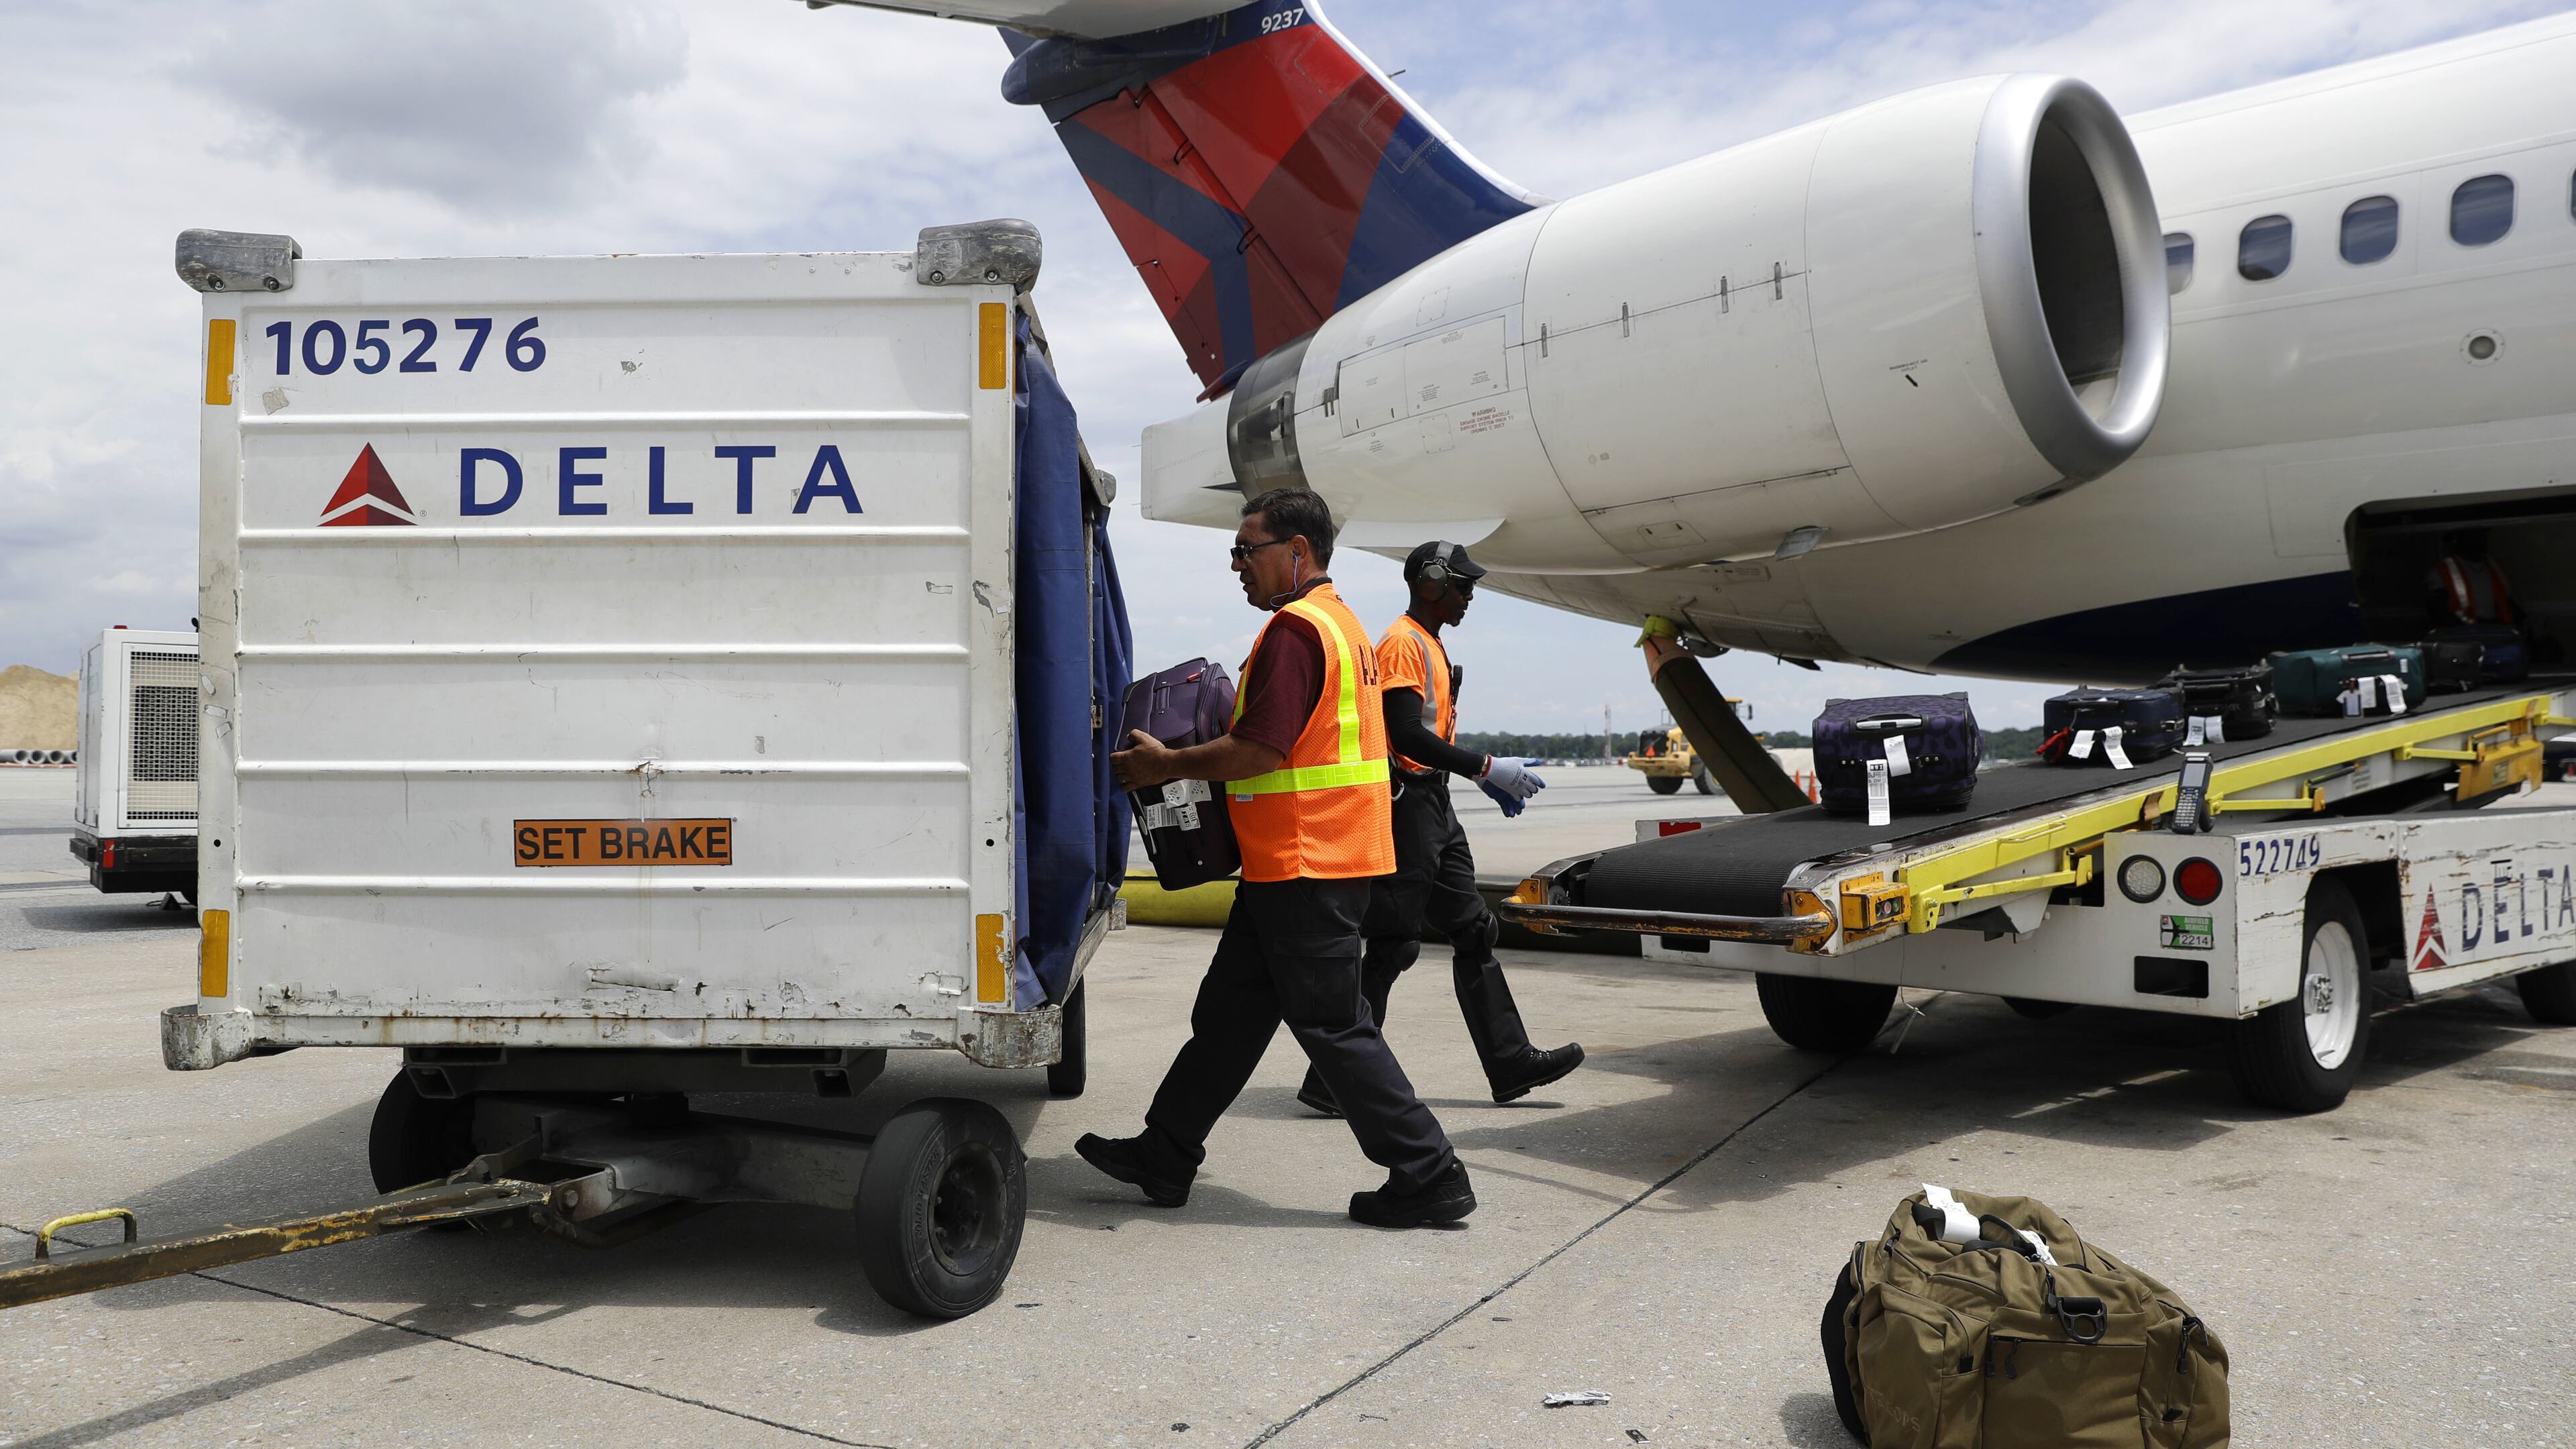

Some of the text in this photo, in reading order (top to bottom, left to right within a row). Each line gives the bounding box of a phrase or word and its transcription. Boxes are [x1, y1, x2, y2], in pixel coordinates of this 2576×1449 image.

[1261, 7, 1304, 35] 9237
[265, 316, 547, 376] 105276
[460, 445, 864, 516] DELTA
[518, 826, 728, 859] SET BRAKE
[2241, 835, 2320, 876] 522749
[2461, 864, 2575, 951] DELTA
[2182, 934, 2208, 945] 2214
